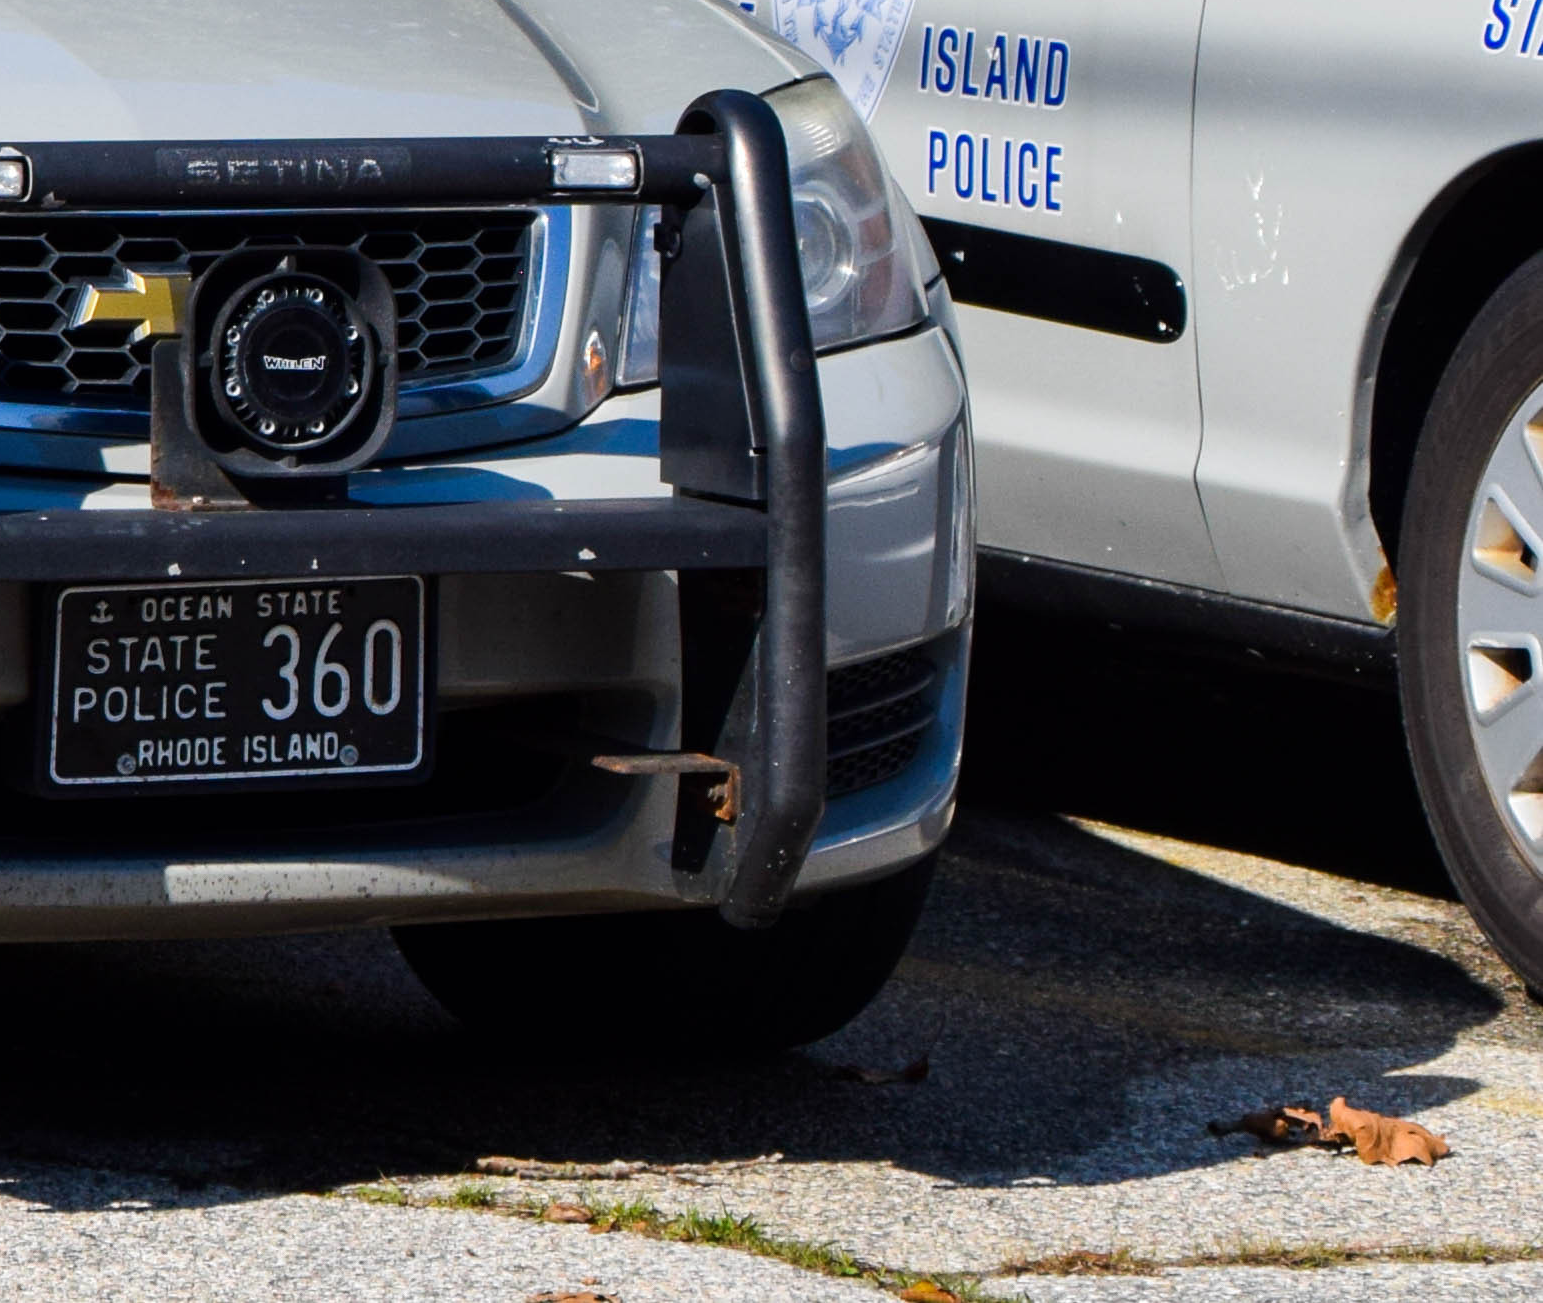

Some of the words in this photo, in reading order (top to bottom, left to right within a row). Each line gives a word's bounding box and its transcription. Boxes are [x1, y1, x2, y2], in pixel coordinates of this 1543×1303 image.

[920, 24, 1071, 109] ISLAND
[927, 128, 1064, 212] POLICE
[262, 354, 328, 371] WHELEN
[141, 595, 233, 623] OCEAN
[257, 590, 342, 618] STATE
[86, 633, 218, 675] STATE
[261, 619, 403, 721] 360
[72, 682, 228, 724] POLICE
[137, 736, 227, 767] RHODE
[243, 731, 340, 764] ISLAND
